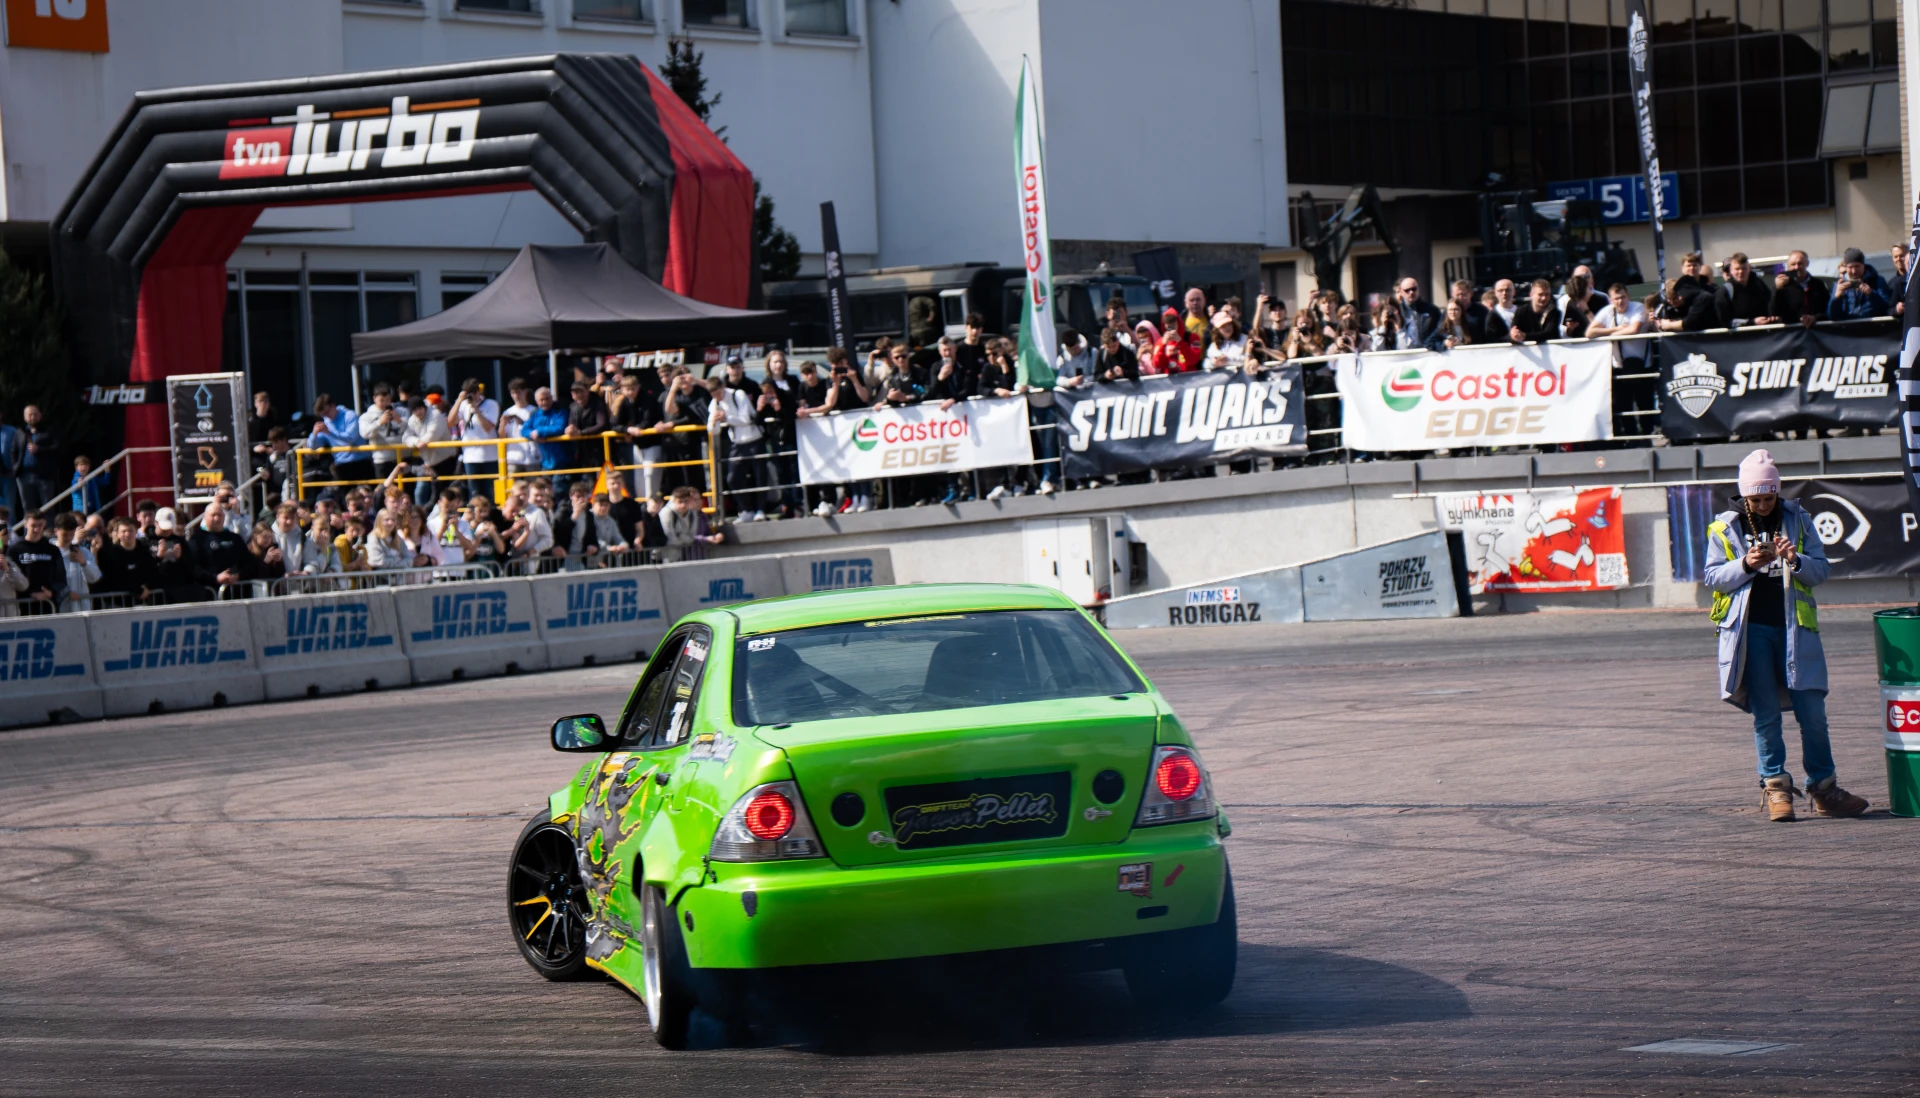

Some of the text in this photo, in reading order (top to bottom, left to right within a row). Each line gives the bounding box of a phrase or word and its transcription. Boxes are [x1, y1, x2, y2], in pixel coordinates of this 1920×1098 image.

[233, 96, 480, 176] tvn turbo
[1601, 183, 1625, 218] 5
[1430, 364, 1567, 401] Castrol
[1728, 355, 1888, 397] STUNT WARS
[883, 415, 968, 444] Castrol
[1068, 379, 1292, 452] STUNT WARS
[1424, 404, 1551, 439] EDGE
[880, 442, 961, 470] EDGE
[1448, 506, 1514, 524] gymkhana
[432, 590, 507, 640] WAAB
[567, 579, 638, 628] WAAB
[1168, 603, 1262, 626] ROMGAZ
[130, 616, 219, 669] WAAB
[287, 603, 368, 654] WAAB
[948, 801, 971, 811] TEAM
[974, 796, 1049, 824] Pellet
